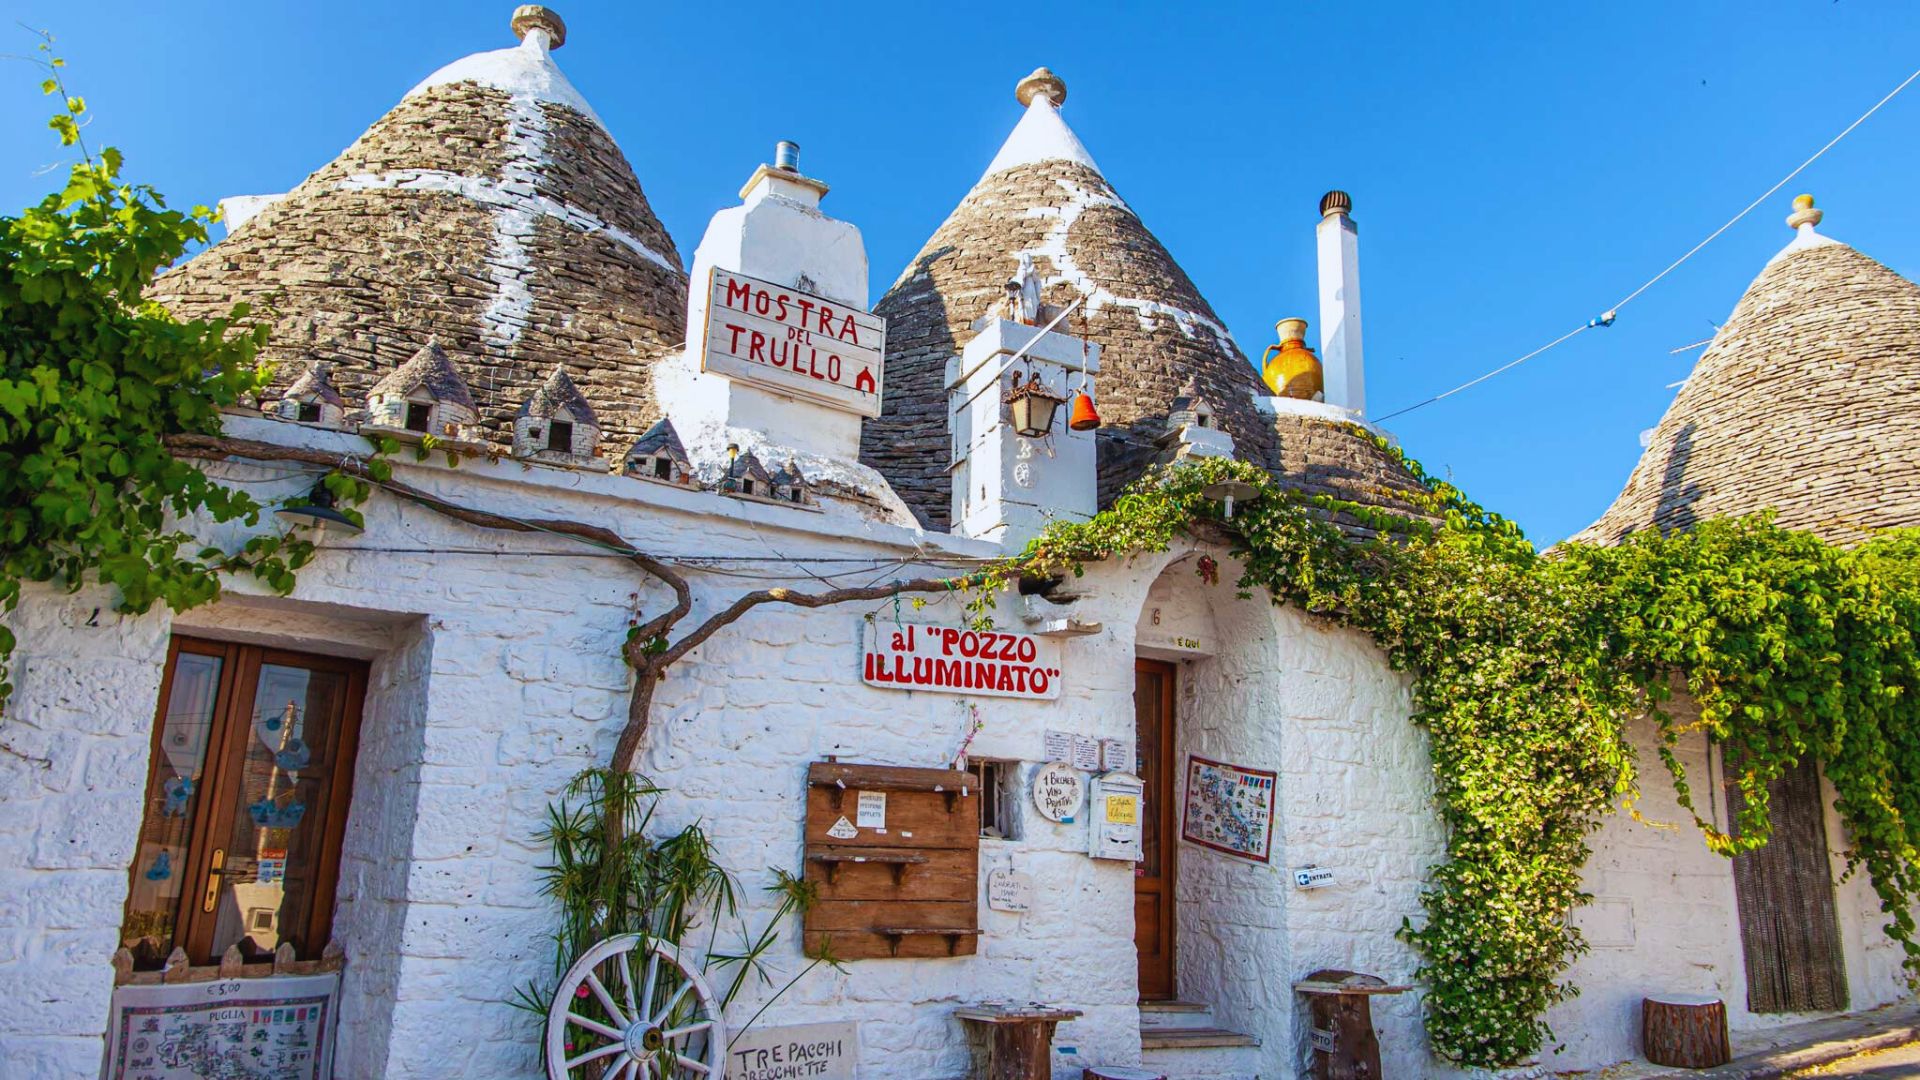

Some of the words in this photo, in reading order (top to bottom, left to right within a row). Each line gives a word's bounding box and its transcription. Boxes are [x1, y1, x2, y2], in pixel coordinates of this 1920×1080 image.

[726, 278, 858, 345] MOSTRA
[788, 327, 812, 346] DEL
[726, 323, 841, 382] TRULLO
[1153, 608, 1160, 625] 6
[891, 625, 915, 652] al
[927, 626, 1037, 663] "POZZO
[864, 652, 1060, 695] ILLUMINATO"
[1309, 872, 1333, 882] ENTRATA
[219, 983, 241, 996] 5,00
[209, 1010, 246, 1022] PUGLIA
[733, 1044, 783, 1072] TRE
[788, 1039, 842, 1063] PACCHI
